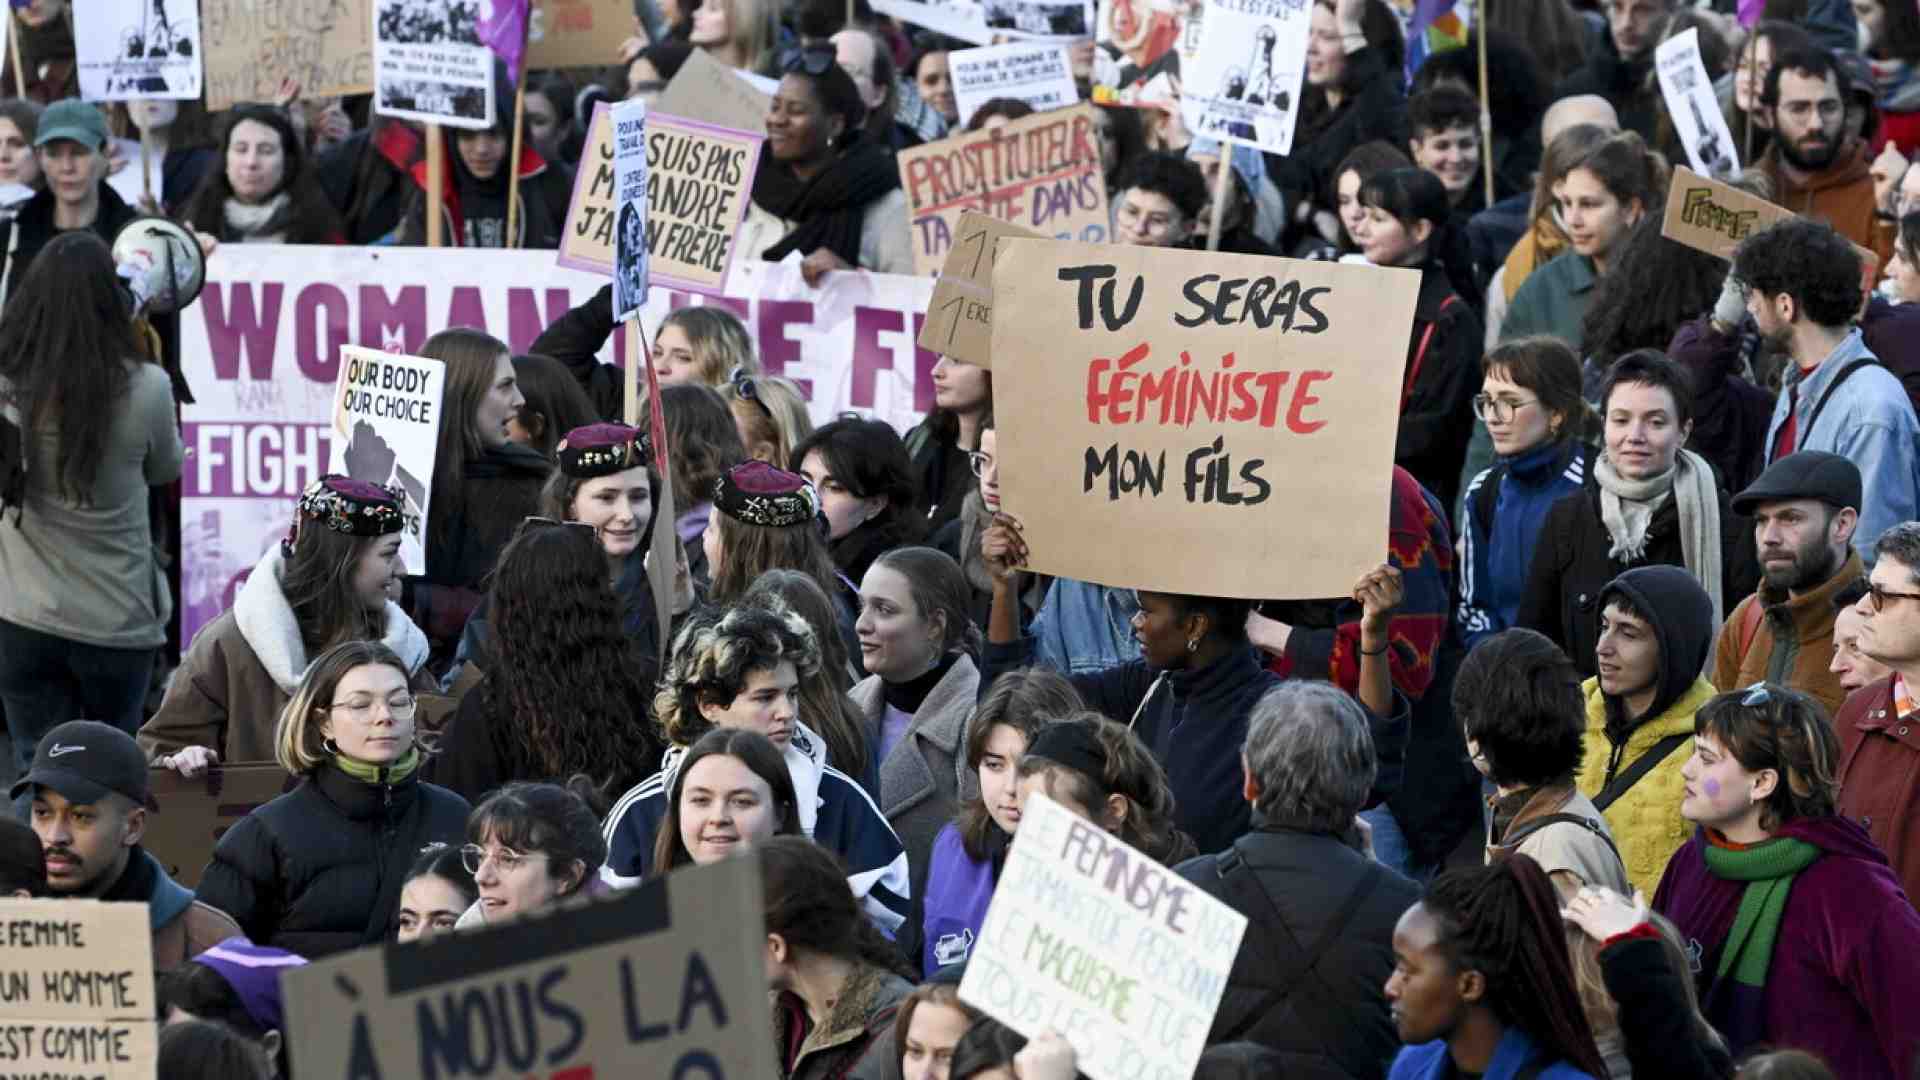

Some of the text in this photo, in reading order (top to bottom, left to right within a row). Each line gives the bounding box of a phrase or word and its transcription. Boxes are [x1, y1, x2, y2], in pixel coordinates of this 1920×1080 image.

[702, 144, 746, 186] PAS
[1032, 171, 1099, 226] DANS
[660, 222, 732, 273] FRÈRE
[1058, 264, 1333, 334] TU SERAS
[347, 357, 431, 396] OUR BODY
[343, 389, 432, 424] OUR CHOICE
[1084, 442, 1166, 501] MON
[9, 920, 86, 948] FEMME
[43, 970, 138, 1009] HOMME
[416, 962, 587, 1080] NOUS
[619, 949, 729, 1043] LA
[41, 1025, 132, 1064] COMME
